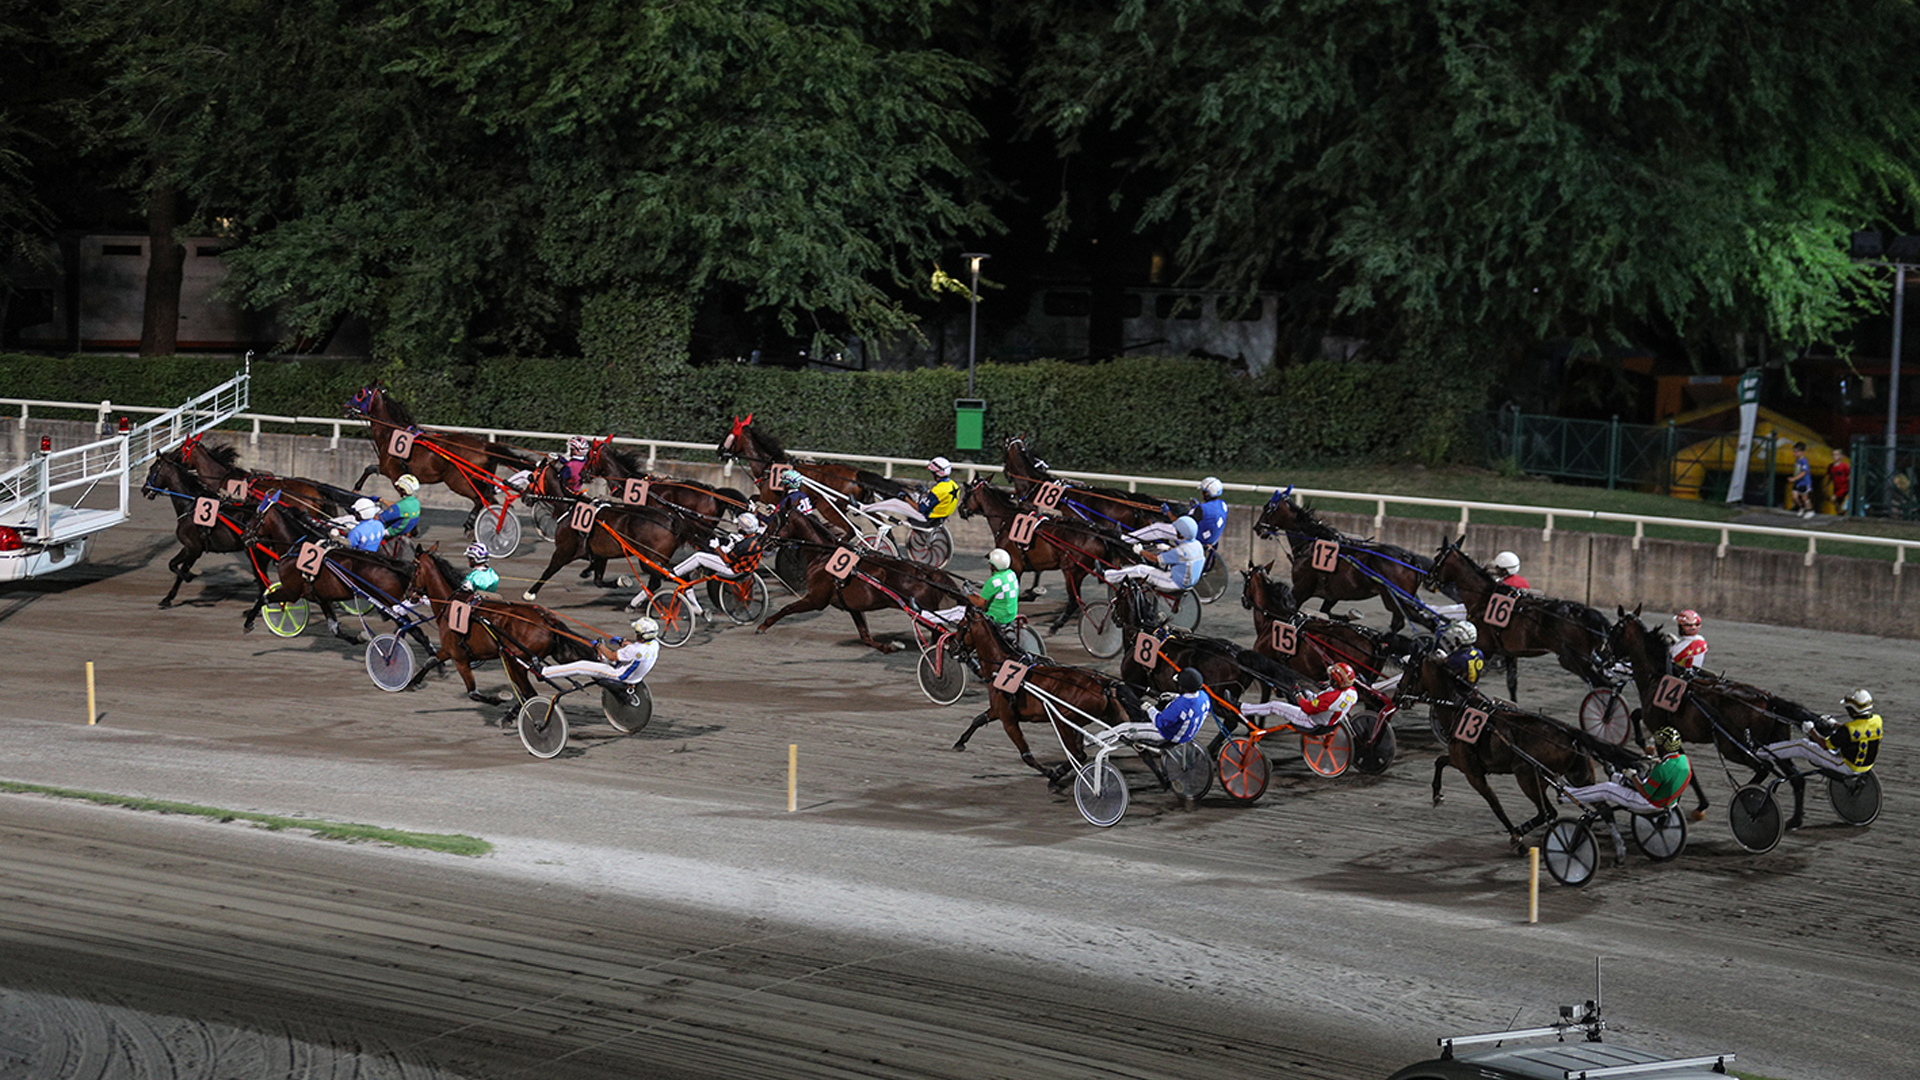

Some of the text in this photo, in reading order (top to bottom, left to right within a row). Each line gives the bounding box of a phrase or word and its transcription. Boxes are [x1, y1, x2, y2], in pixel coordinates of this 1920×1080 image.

[395, 434, 408, 453] 6
[629, 482, 642, 503] 5
[1037, 485, 1060, 506] 18
[200, 501, 212, 522] 3
[574, 505, 593, 529] 10
[1014, 518, 1033, 540] 11
[302, 548, 318, 571] 2
[833, 553, 851, 572] 9
[1315, 544, 1336, 567] 17
[1488, 597, 1511, 623] 16
[1274, 625, 1294, 651] 15
[1140, 639, 1153, 662] 8
[1002, 664, 1021, 687] 7
[1657, 679, 1682, 707] 14
[1459, 712, 1483, 739] 13
